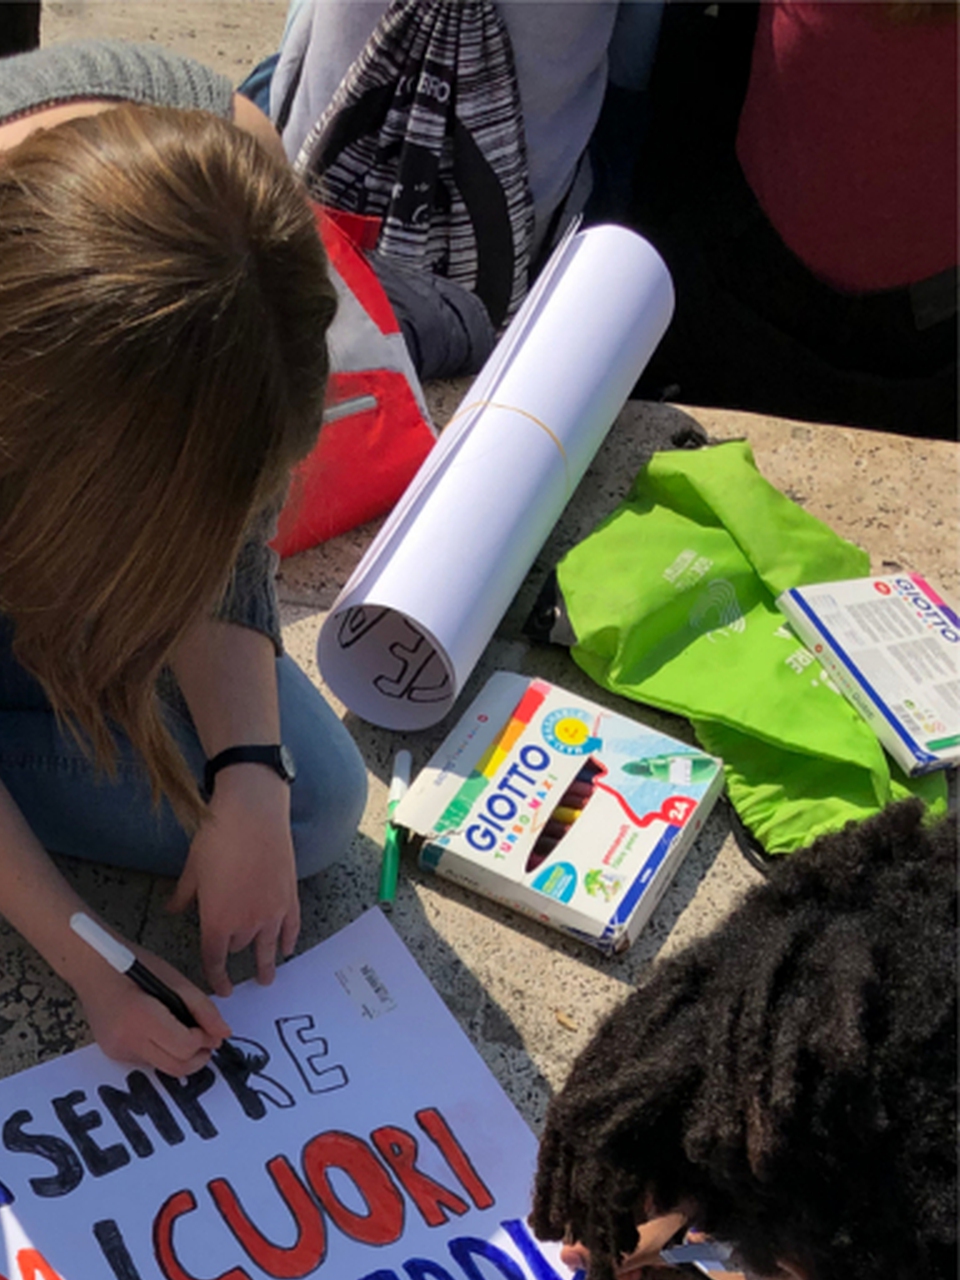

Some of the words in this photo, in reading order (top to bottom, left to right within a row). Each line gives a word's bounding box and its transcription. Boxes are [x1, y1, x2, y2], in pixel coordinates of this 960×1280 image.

[895, 578, 959, 643] GIOTTO
[465, 744, 551, 852] GIOTTO
[494, 813, 531, 861] TURBO
[527, 773, 558, 811] MAXI
[668, 800, 690, 821] 24
[1, 1013, 350, 1198] SEMPRE
